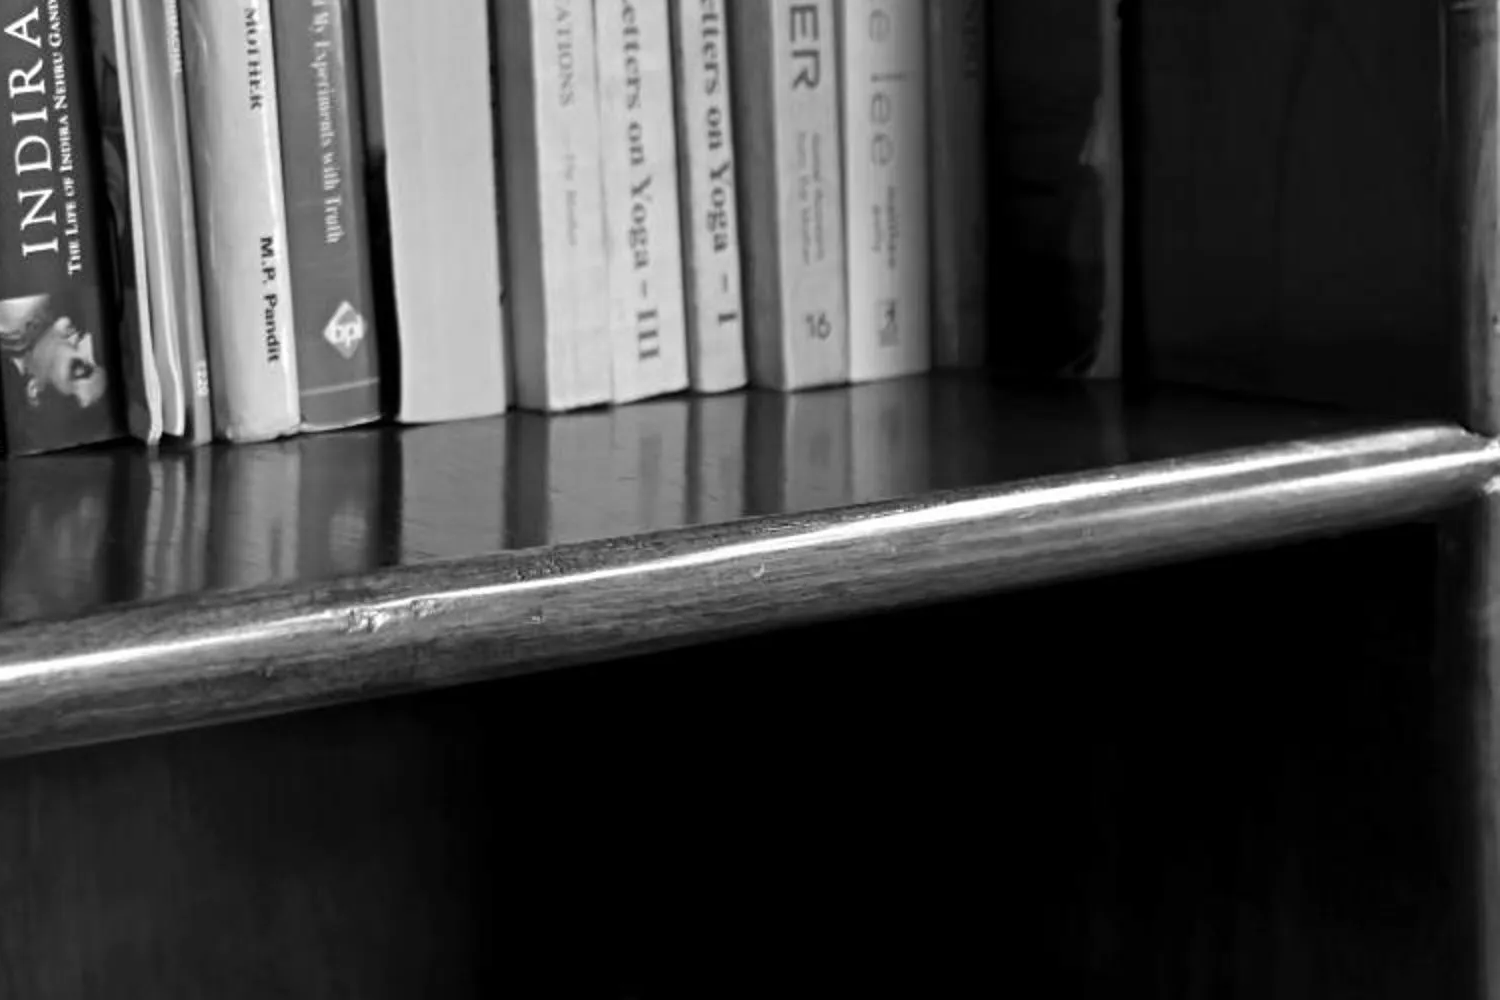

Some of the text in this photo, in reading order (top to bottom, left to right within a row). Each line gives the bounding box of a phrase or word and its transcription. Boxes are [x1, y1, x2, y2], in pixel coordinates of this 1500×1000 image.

[243, 7, 264, 111] MOTHER
[3, 6, 59, 258] INDIRA
[627, 120, 646, 166] on
[706, 104, 724, 151] on
[869, 71, 908, 168] lee
[322, 153, 340, 191] with
[323, 196, 346, 244] Truth
[706, 159, 731, 255] Yoga
[628, 173, 653, 270] Yoga
[260, 235, 283, 363] M.P. Pandit
[635, 308, 661, 362] III
